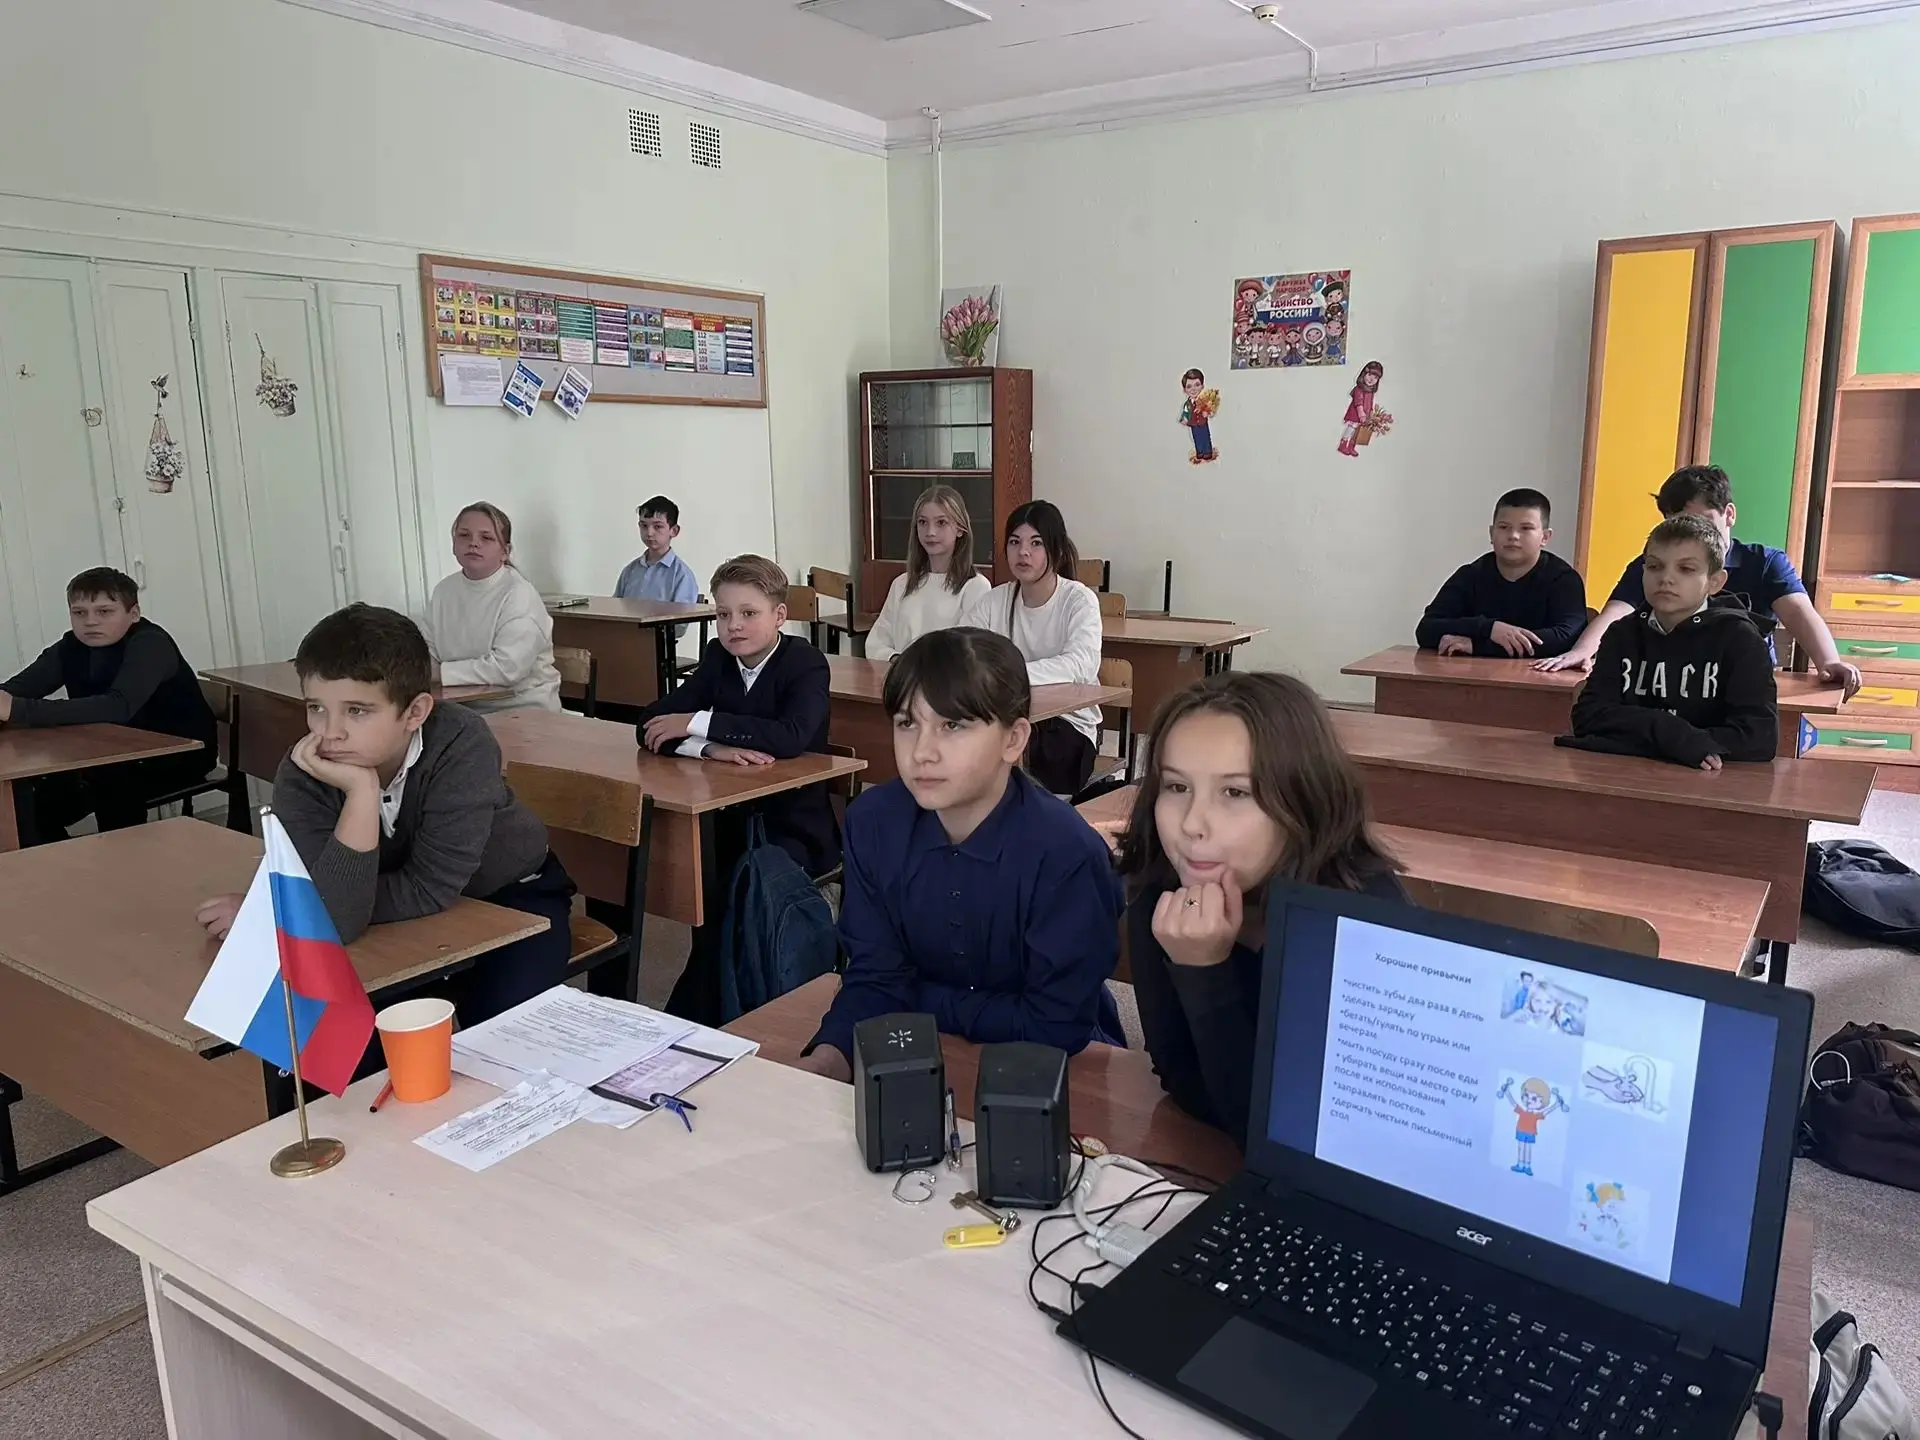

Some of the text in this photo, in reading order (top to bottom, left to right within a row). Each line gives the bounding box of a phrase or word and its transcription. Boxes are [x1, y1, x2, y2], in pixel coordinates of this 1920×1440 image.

[1270, 298, 1314, 308] ЕДИНСТВО
[1270, 308, 1312, 320] РОССИИ!
[1622, 657, 1719, 698] BLACK
[1375, 952, 1472, 984] Хорошие привычки
[1345, 994, 1416, 1022] делать зарядку
[1348, 980, 1381, 995] чистить
[1383, 988, 1406, 1002] зубы
[1408, 996, 1426, 1007] два
[1427, 1000, 1450, 1013] раза
[1459, 1010, 1484, 1022] день
[1338, 1022, 1378, 1040] вечерам
[1407, 1027, 1419, 1038] по
[1420, 1032, 1450, 1047] утрам
[1452, 1040, 1471, 1052] или
[1340, 1040, 1479, 1086] мыть посуду сразу после еды
[1342, 1054, 1478, 1104] убирать вещи на место сразу
[1334, 1064, 1446, 1106] после их использования
[1337, 1082, 1426, 1117] заправлять постель
[1330, 1108, 1350, 1122] стол
[1334, 1097, 1473, 1148] держать чистым письменный
[1456, 1226, 1492, 1245] acer
